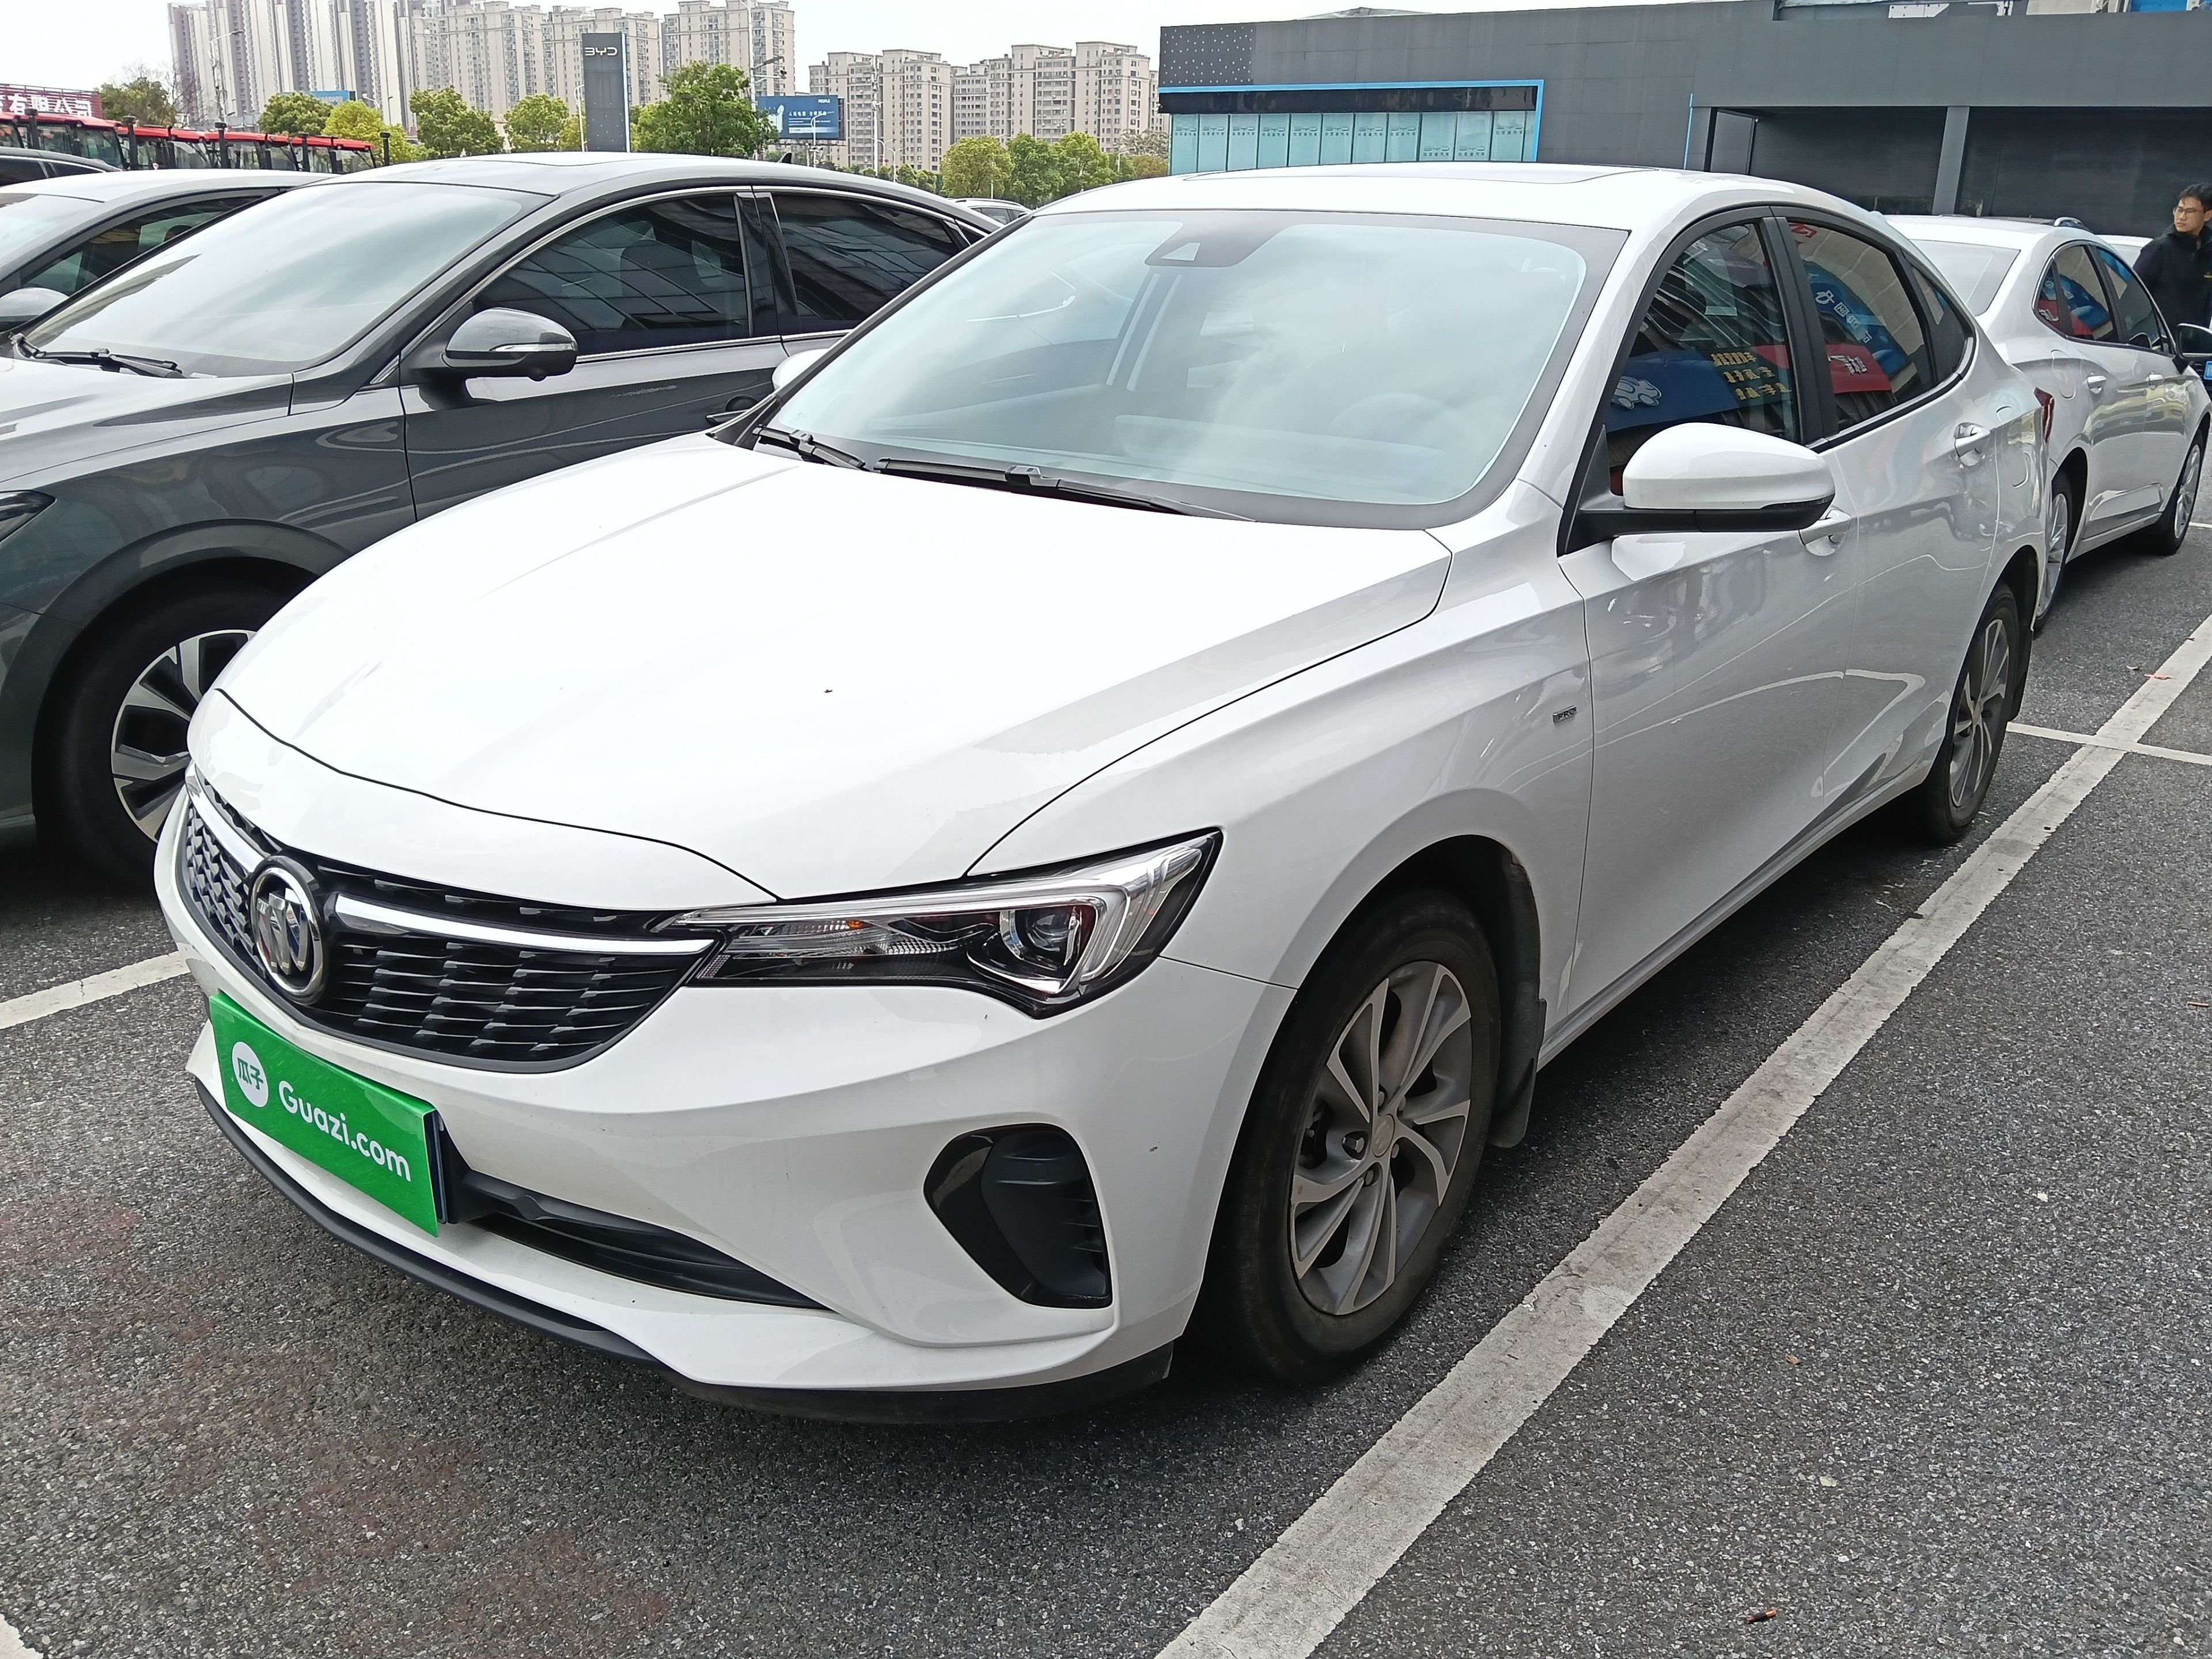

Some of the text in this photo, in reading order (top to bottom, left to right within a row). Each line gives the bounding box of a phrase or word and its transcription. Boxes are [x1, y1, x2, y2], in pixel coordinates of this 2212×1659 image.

[584, 46, 618, 56] BYD
[237, 1056, 264, 1090] 瓜子
[278, 1080, 411, 1182] Guazi.com
